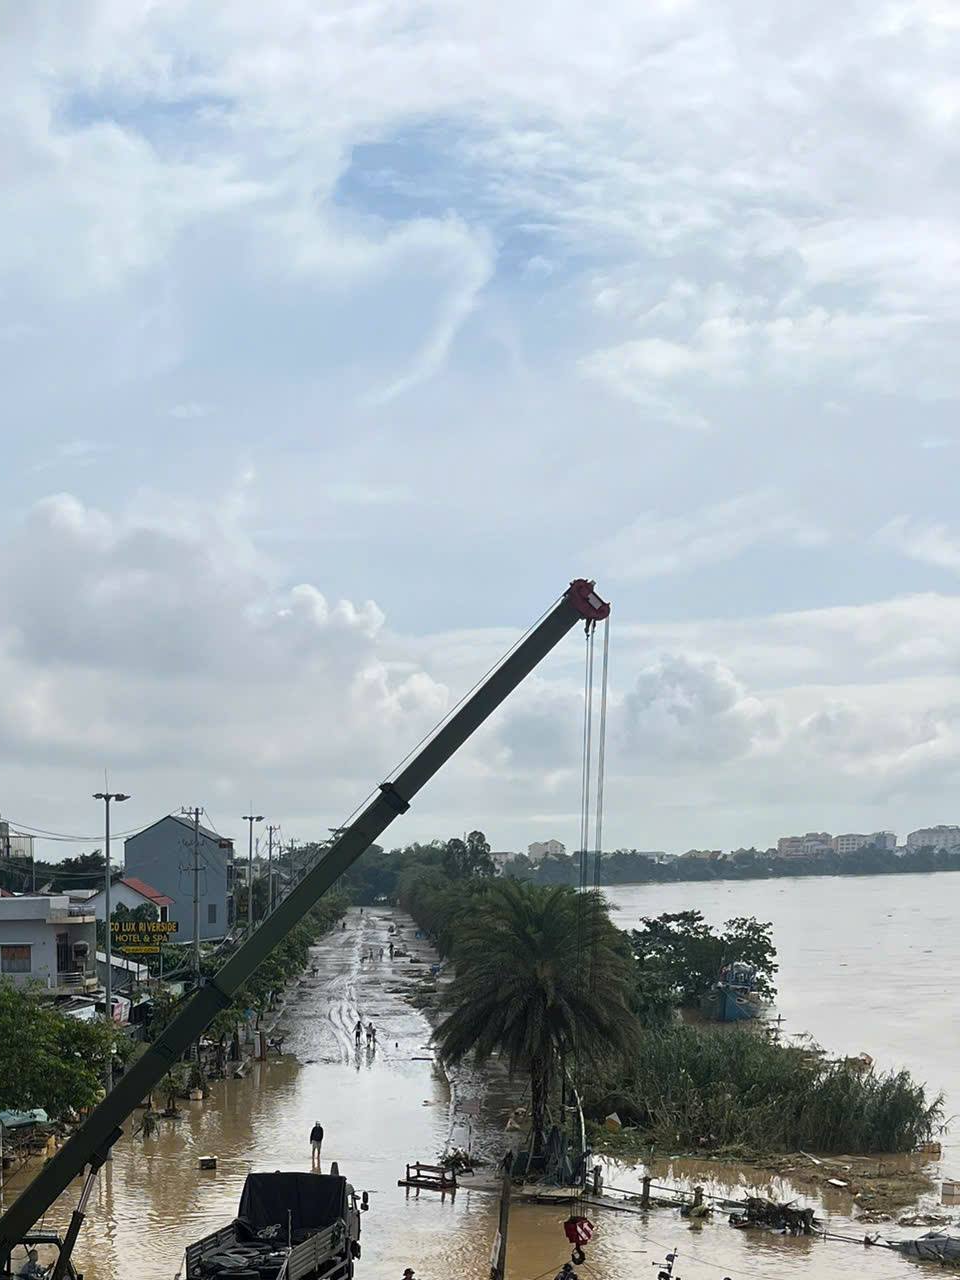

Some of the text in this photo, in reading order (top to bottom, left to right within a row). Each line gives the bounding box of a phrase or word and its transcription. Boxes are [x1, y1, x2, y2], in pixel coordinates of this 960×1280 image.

[122, 922, 136, 932] LUX
[115, 934, 140, 942] HOTEL
[152, 934, 168, 942] SPA
